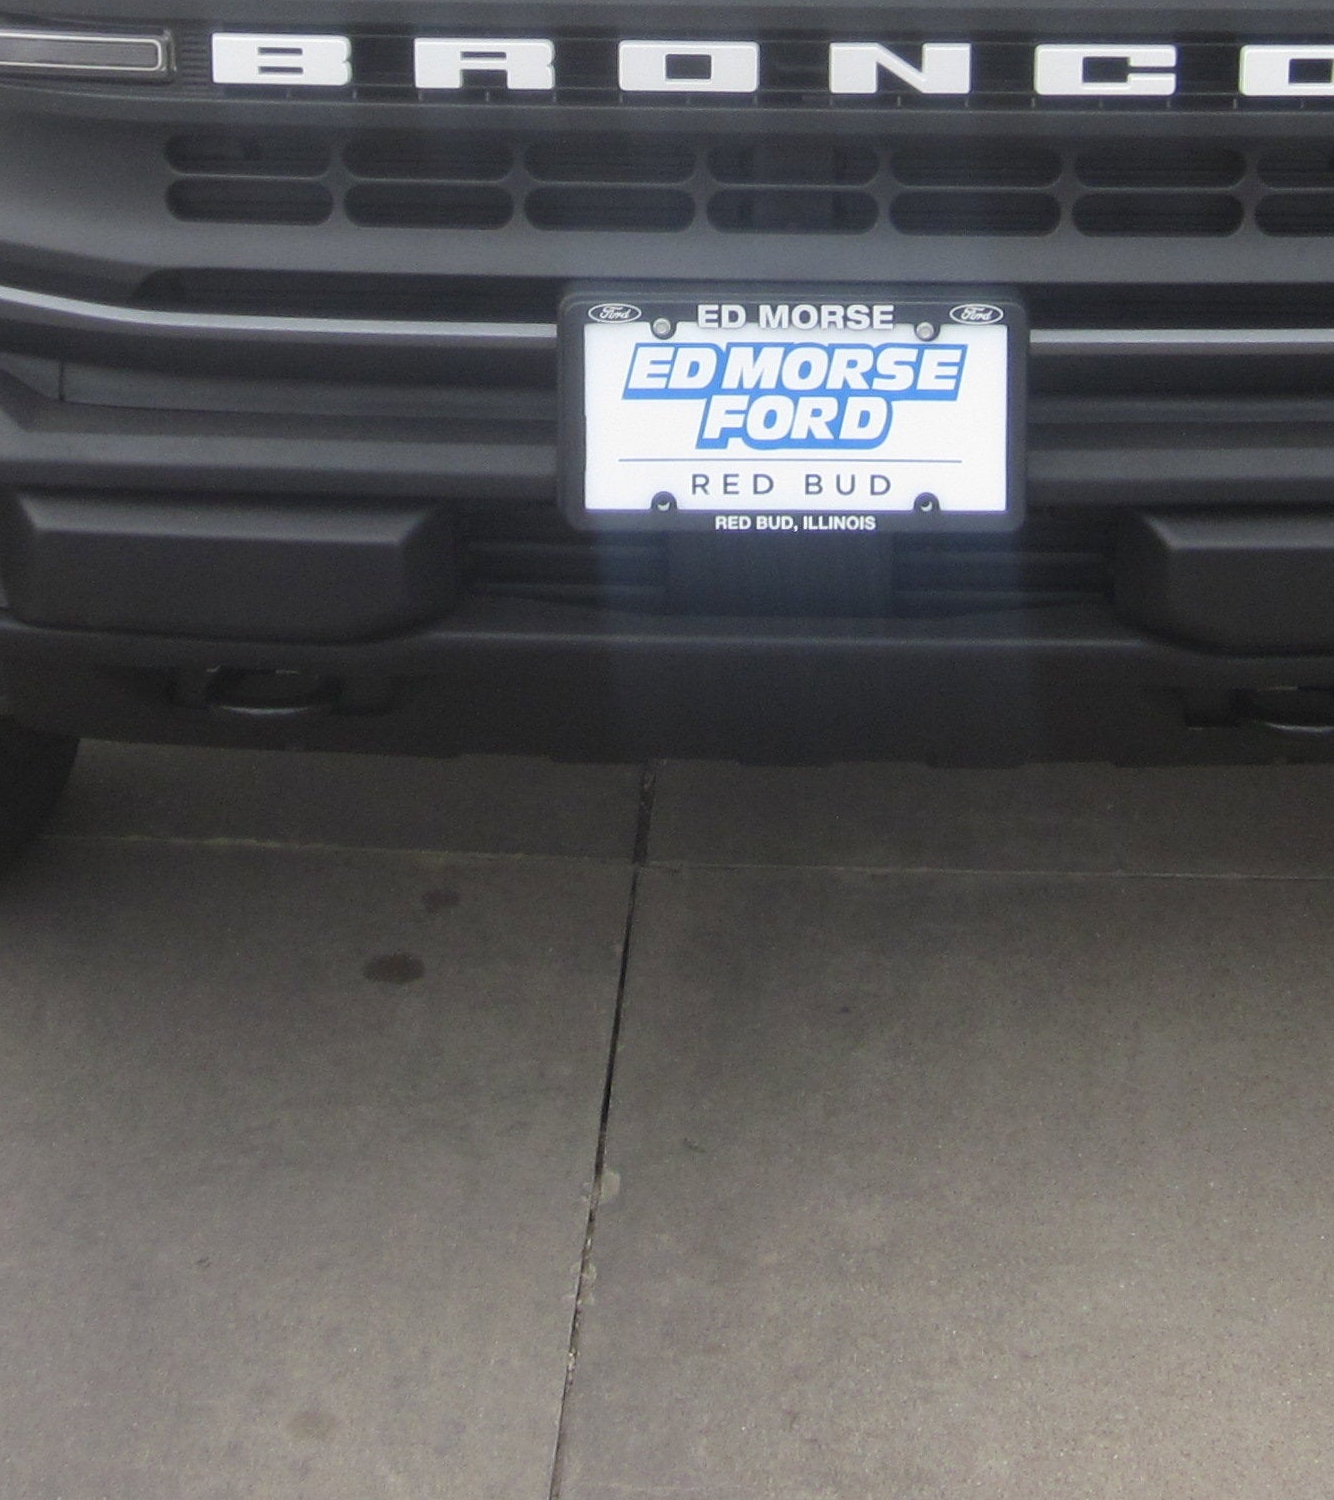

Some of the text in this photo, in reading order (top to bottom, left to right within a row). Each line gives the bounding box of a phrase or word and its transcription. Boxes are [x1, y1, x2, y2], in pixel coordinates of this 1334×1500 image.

[698, 304, 895, 330] ED MORSE
[625, 344, 965, 394] ED MORSE
[699, 395, 890, 444] FORD
[691, 473, 891, 496] RED BUD
[715, 515, 877, 533] RED BUD, ILLINOIS
